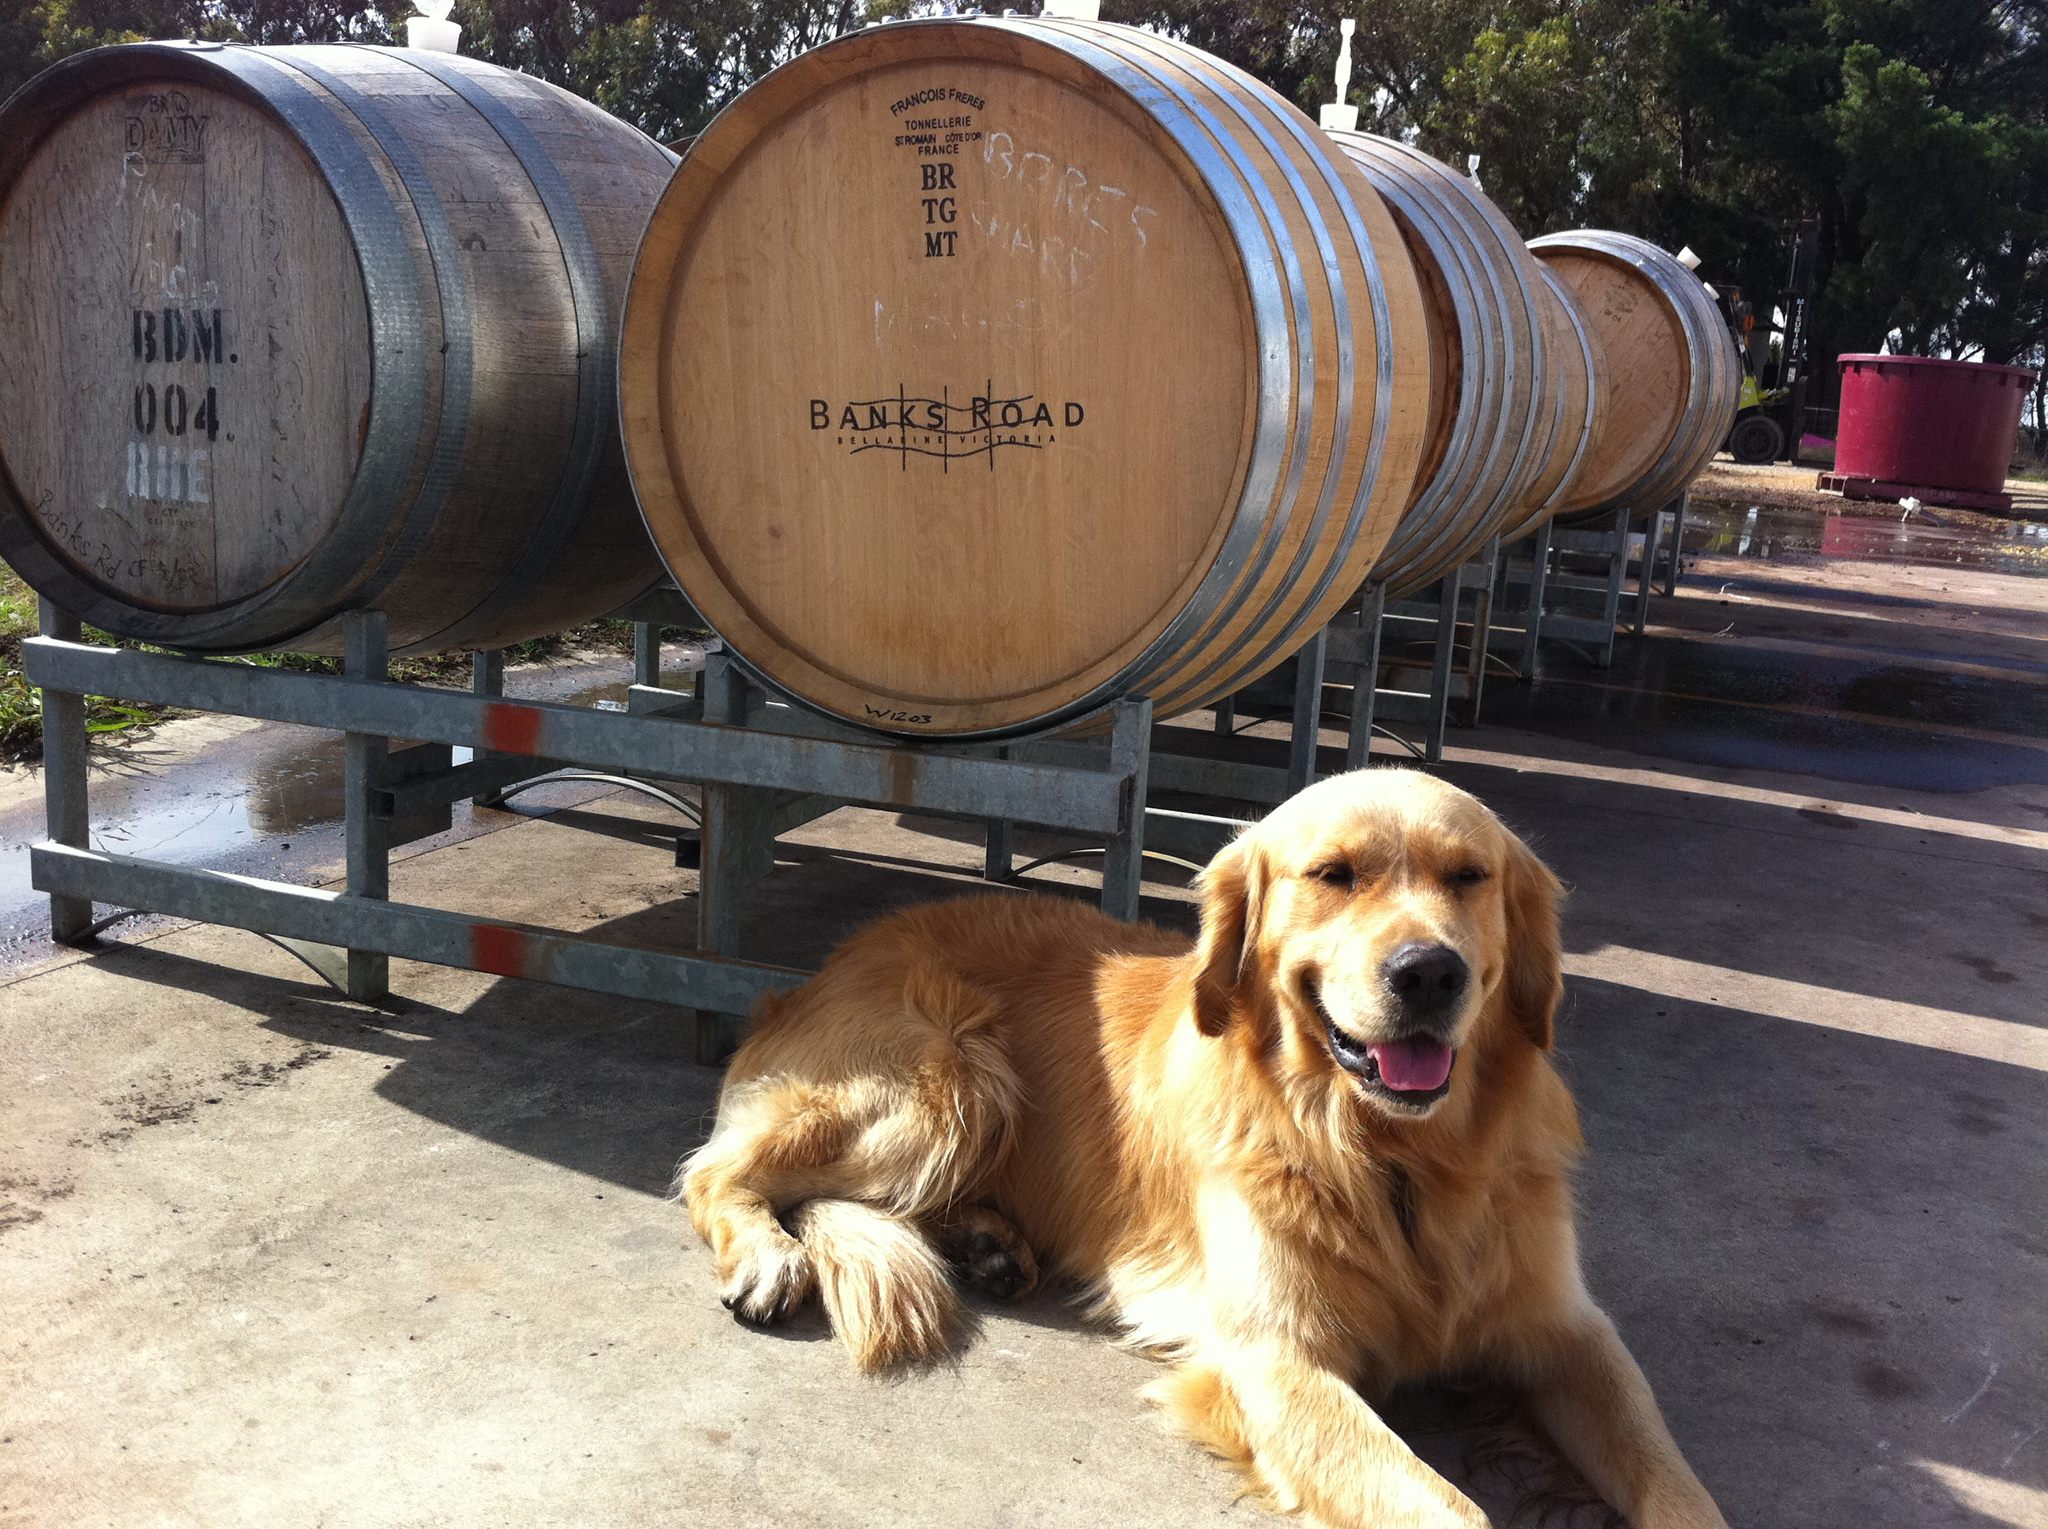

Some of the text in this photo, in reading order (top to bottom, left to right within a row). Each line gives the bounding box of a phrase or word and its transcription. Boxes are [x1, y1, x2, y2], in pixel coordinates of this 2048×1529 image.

[890, 88, 985, 117] FRANÇOIS FRERES
[904, 115, 971, 131] TONNELLERIE
[918, 144, 960, 156] FRANCE
[921, 162, 956, 190] BR
[921, 197, 957, 224] TG
[924, 231, 958, 257] MT
[809, 396, 1085, 431] BANKS ROAD
[959, 434, 1057, 445] VICTORIA
[865, 703, 932, 724] W1203
